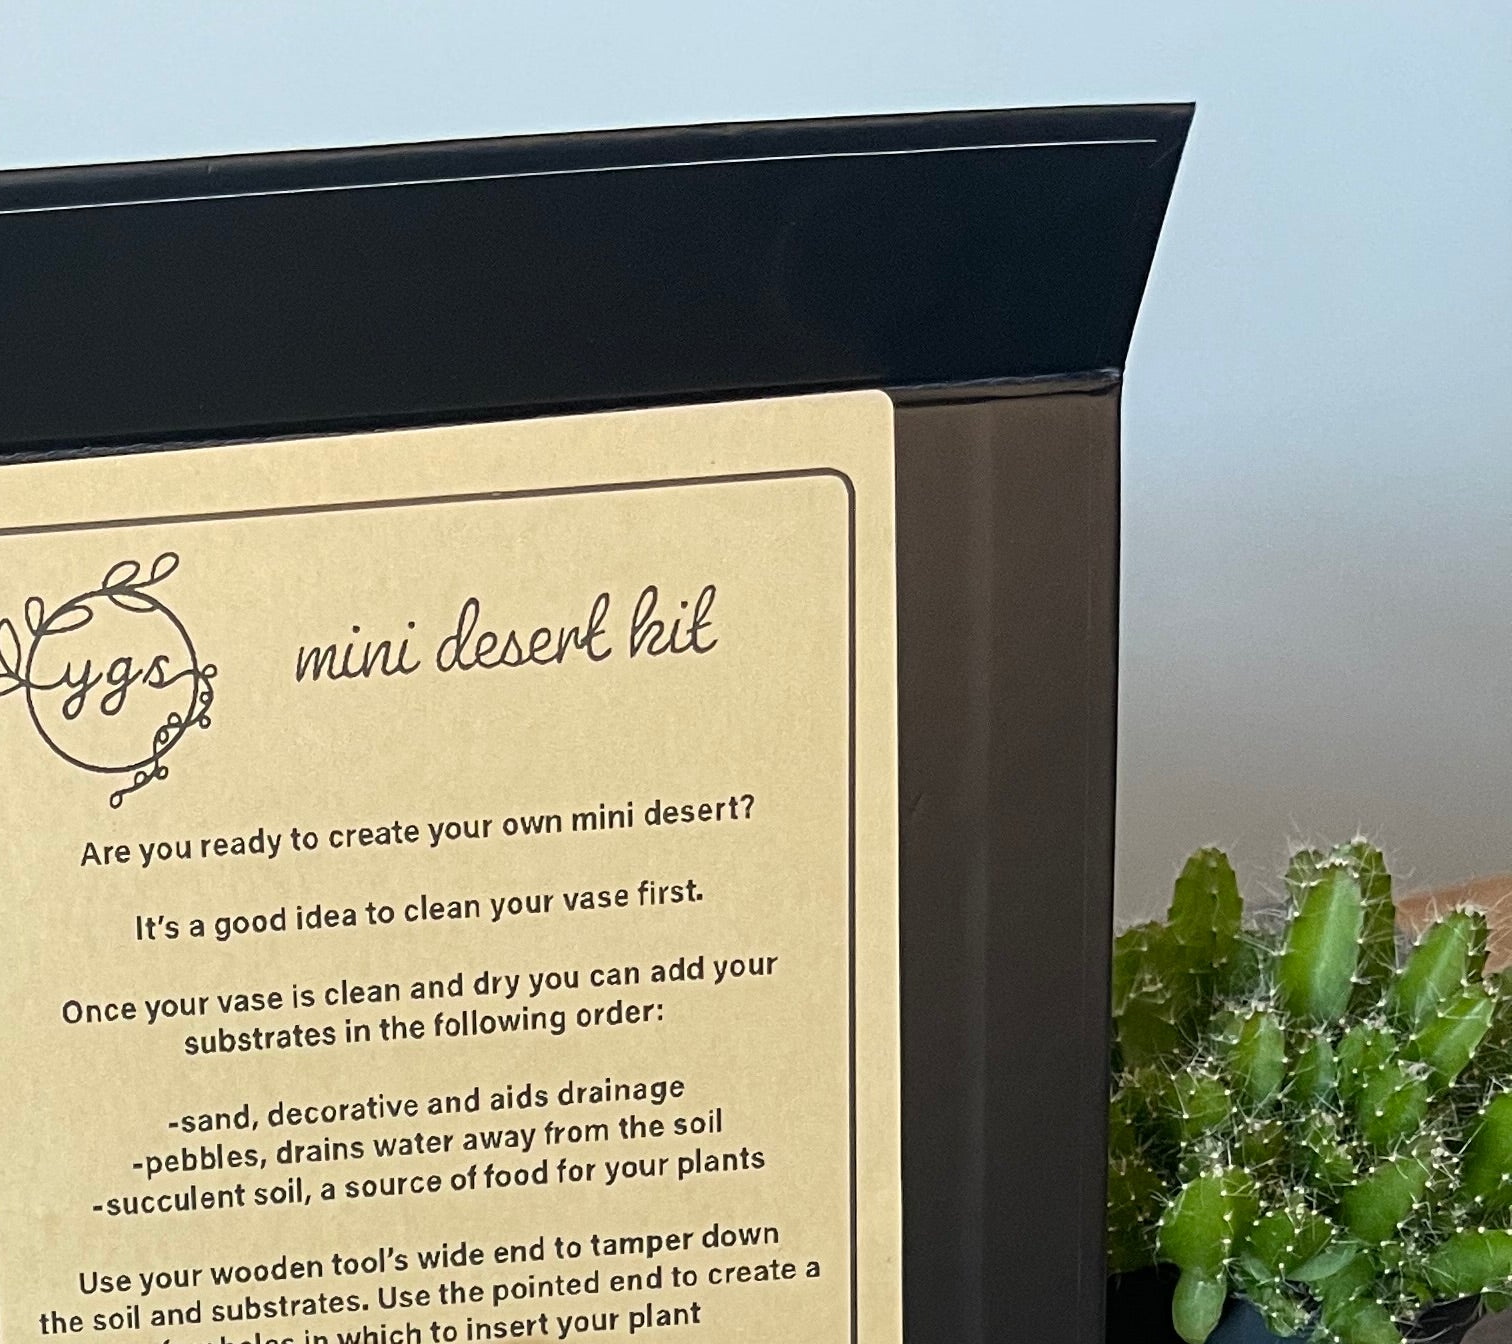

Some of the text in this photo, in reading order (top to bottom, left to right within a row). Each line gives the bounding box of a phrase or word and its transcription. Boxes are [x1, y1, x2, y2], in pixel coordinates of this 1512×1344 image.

[296, 585, 718, 683] mini desert kit
[81, 794, 754, 868] Are you ready to create your own mini desert?
[137, 880, 703, 941] It's a good idea to clean your vase first.
[63, 956, 778, 1025] Once your vase is clean and dry you can add your
[185, 1000, 662, 1055] substrates in the following order:
[169, 1078, 684, 1133] -sand, decorative and aids drainage
[133, 1108, 721, 1180] -pebbles, drains water away from the soil
[93, 1147, 765, 1216] -succulent soil, a source of food for your plants
[79, 1223, 778, 1296] Use your wooden tool's wide end to tamper down
[39, 1260, 820, 1334] the soil and substrates. Use the pointed end to create a
[430, 1321, 457, 1343] to
[467, 1313, 548, 1341] insert
[557, 1313, 619, 1340] your
[629, 1302, 701, 1334] plant
